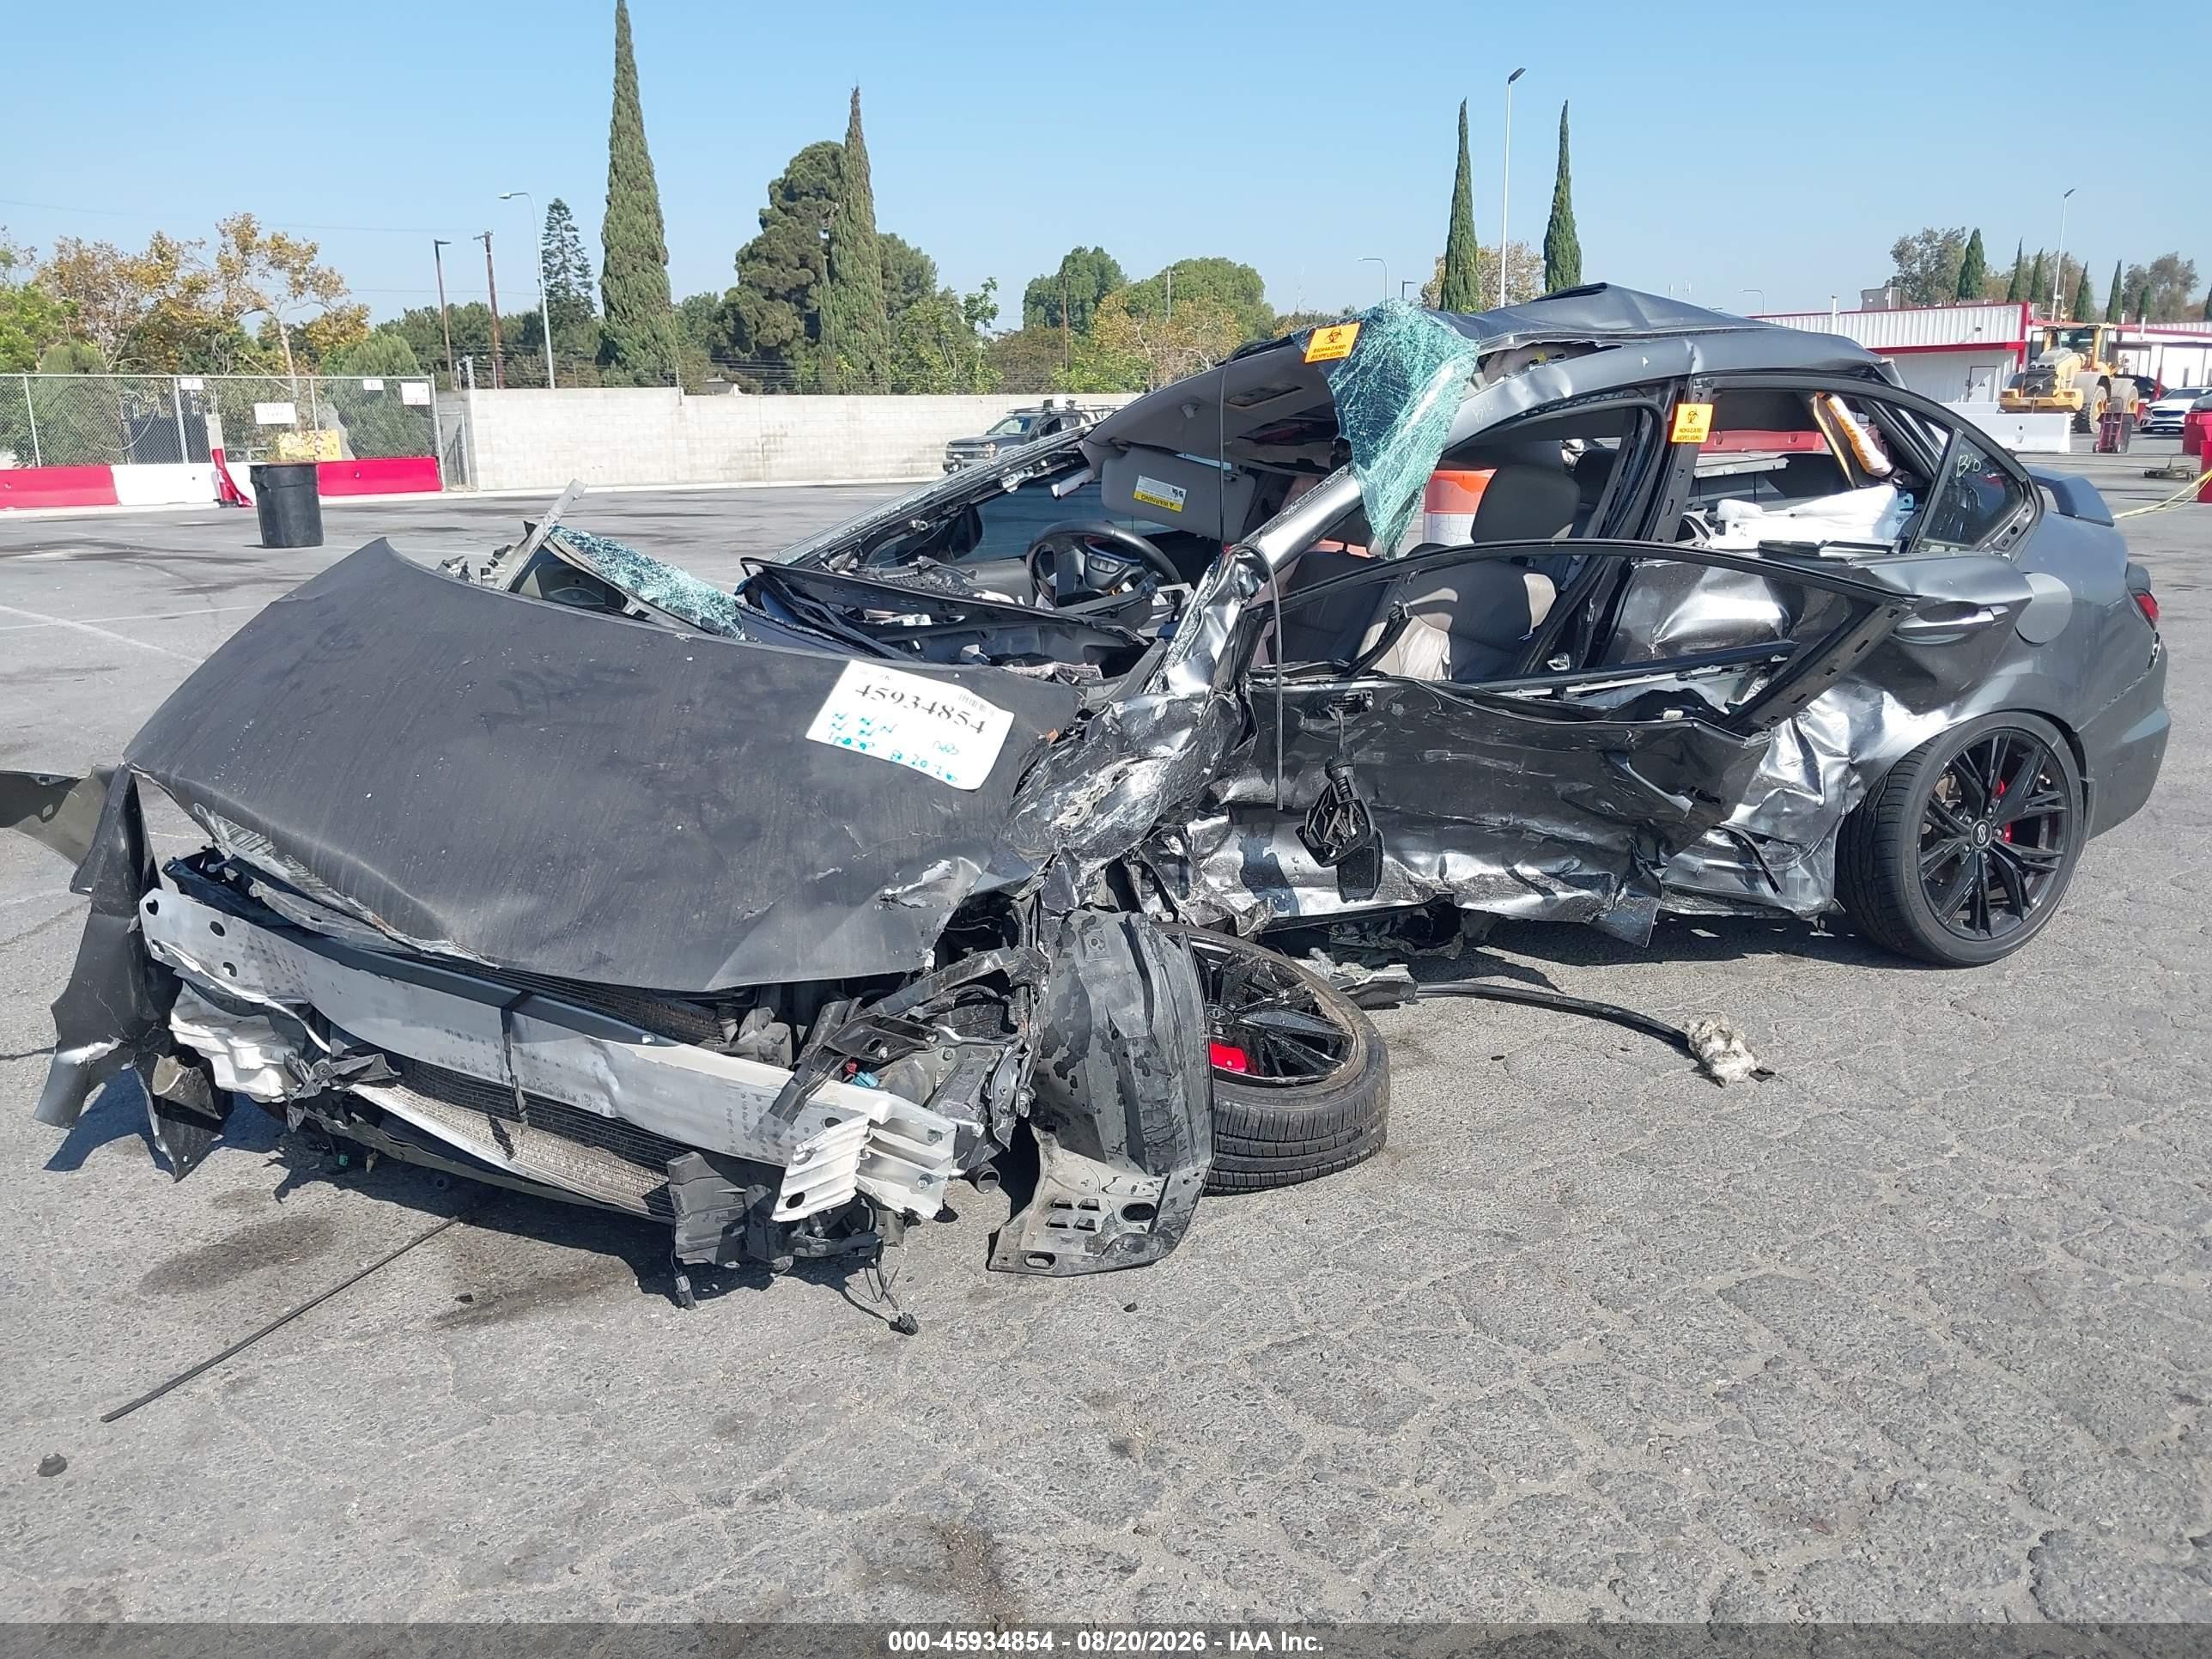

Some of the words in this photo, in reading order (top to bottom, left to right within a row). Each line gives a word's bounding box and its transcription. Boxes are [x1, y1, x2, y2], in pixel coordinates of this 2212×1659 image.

[1313, 344, 1346, 353] BIOHAZARD
[1140, 494, 1169, 507] WARNING
[855, 684, 986, 734] 45934854
